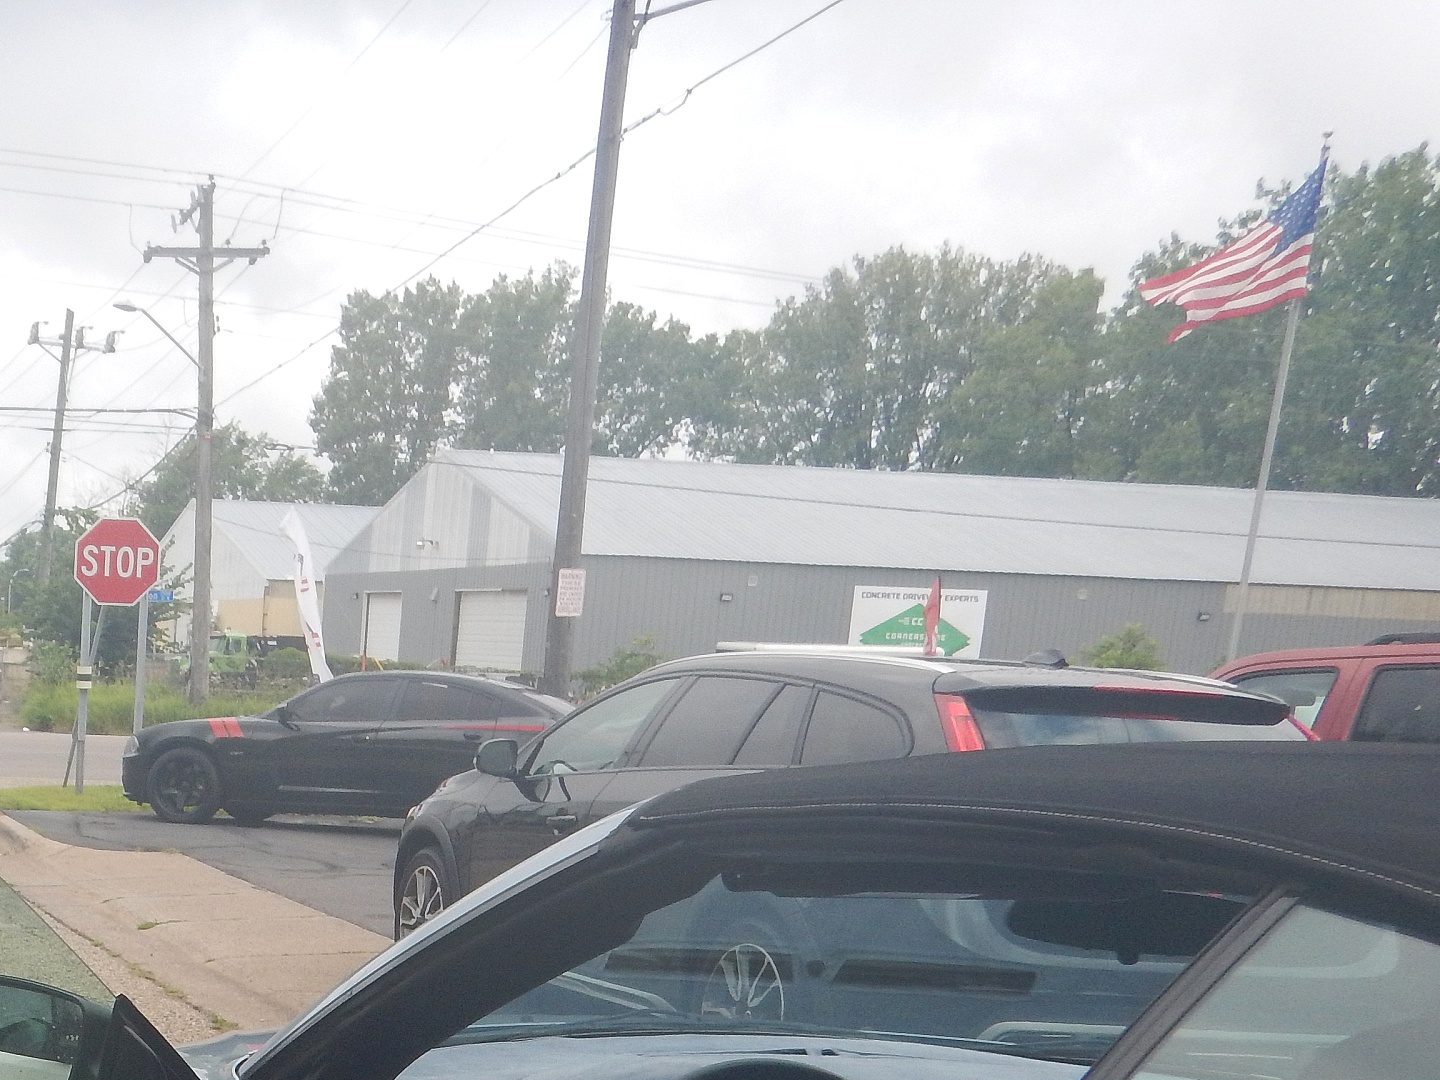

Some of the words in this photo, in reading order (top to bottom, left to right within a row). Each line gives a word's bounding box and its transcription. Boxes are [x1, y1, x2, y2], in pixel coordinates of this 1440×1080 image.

[81, 544, 154, 578] STOP
[861, 591, 901, 600] CONCRETE
[944, 594, 979, 602] EXPERTS
[885, 632, 946, 641] CORNERSE
